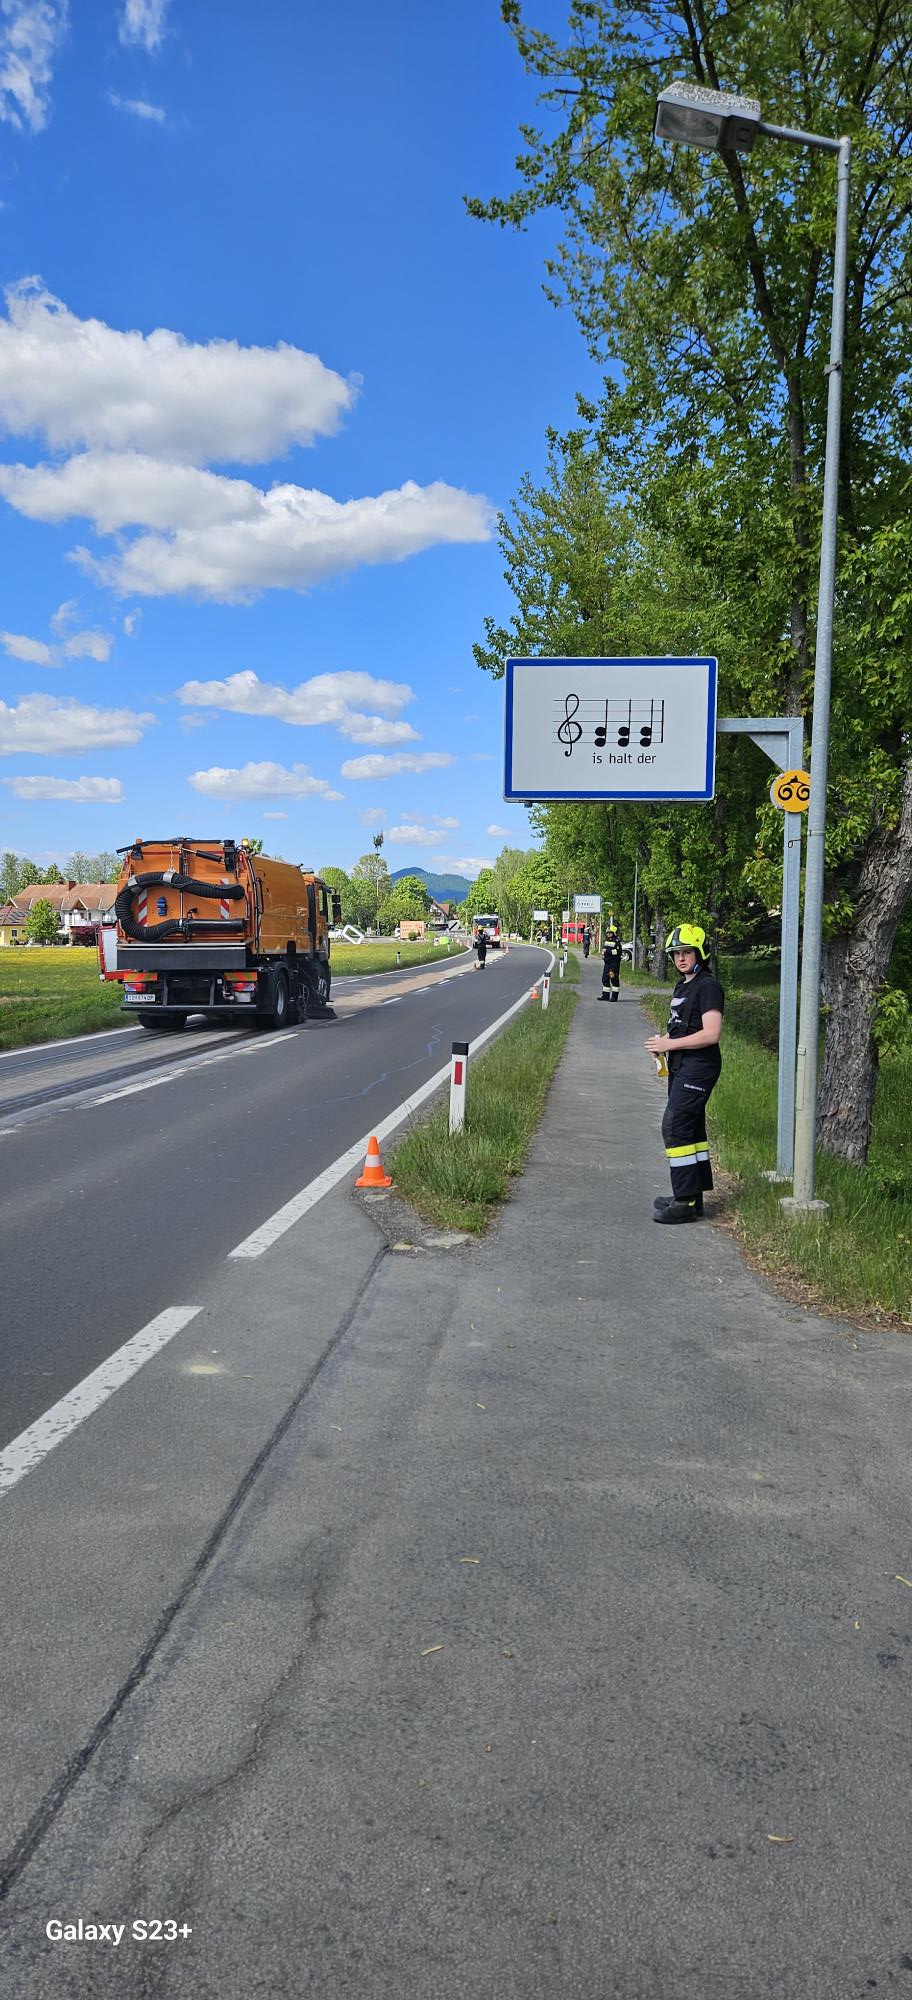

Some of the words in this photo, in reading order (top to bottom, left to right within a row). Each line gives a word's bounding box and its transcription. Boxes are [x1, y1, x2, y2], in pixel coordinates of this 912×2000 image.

[592, 752, 603, 764] is
[609, 752, 633, 764] halt
[637, 752, 657, 764] der
